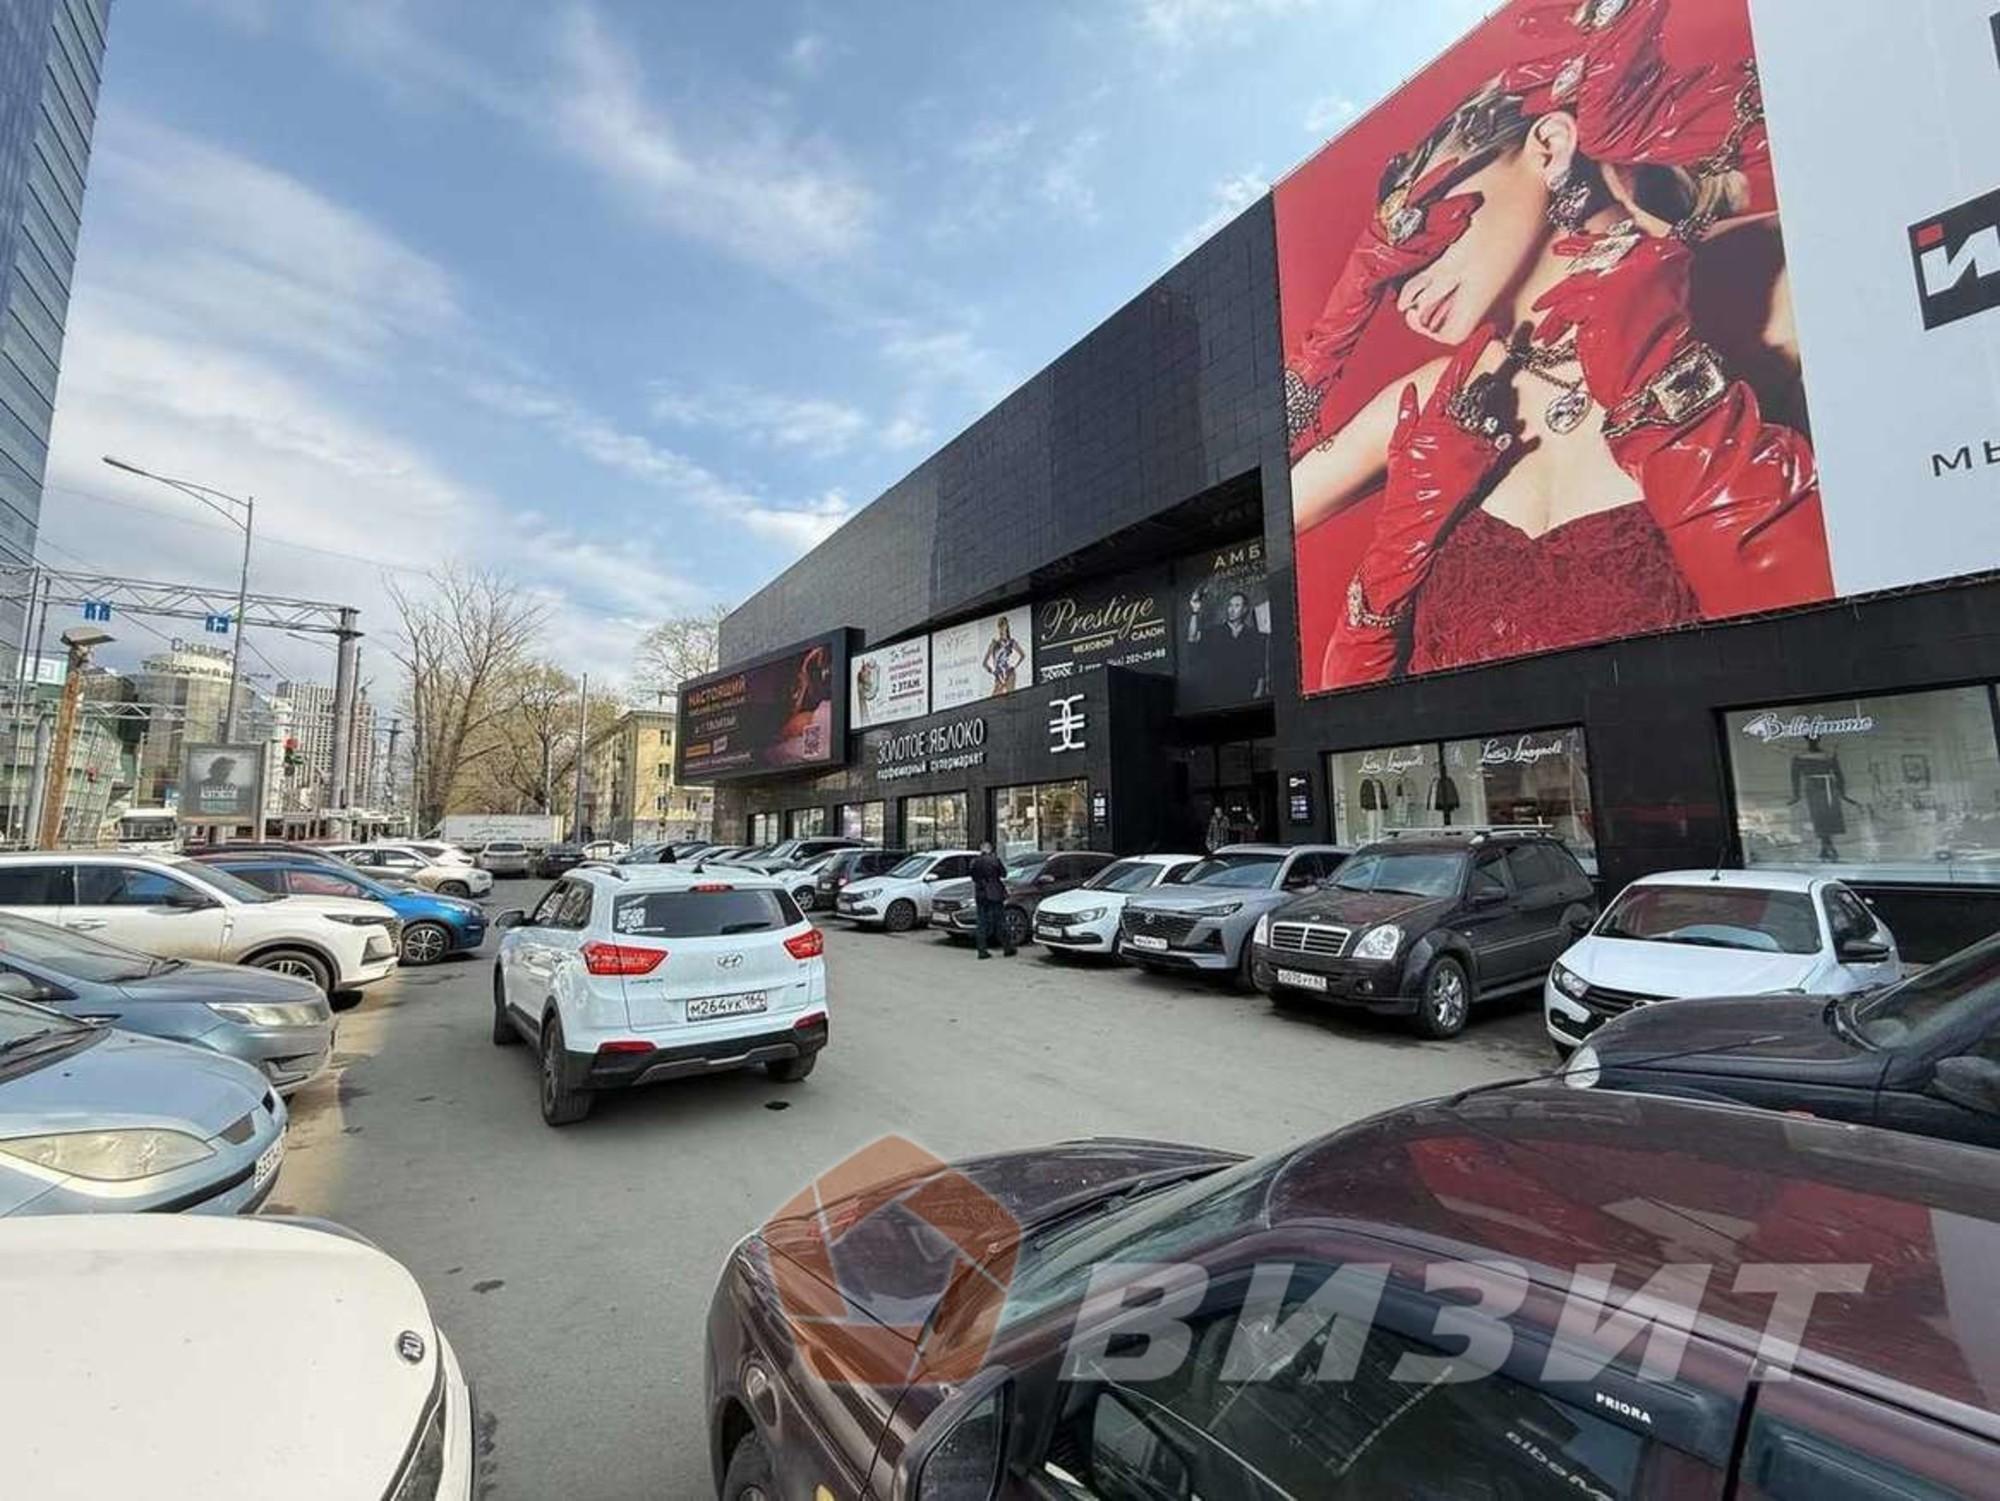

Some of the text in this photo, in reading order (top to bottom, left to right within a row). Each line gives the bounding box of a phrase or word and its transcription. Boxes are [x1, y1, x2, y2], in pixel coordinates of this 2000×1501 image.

[1040, 594, 1154, 641] Prestige
[1131, 626, 1165, 641] САЛОН
[878, 717, 984, 765] ЗОЛОТОЕ ЯБЛОКО
[1595, 1392, 1652, 1425] PRIORA
